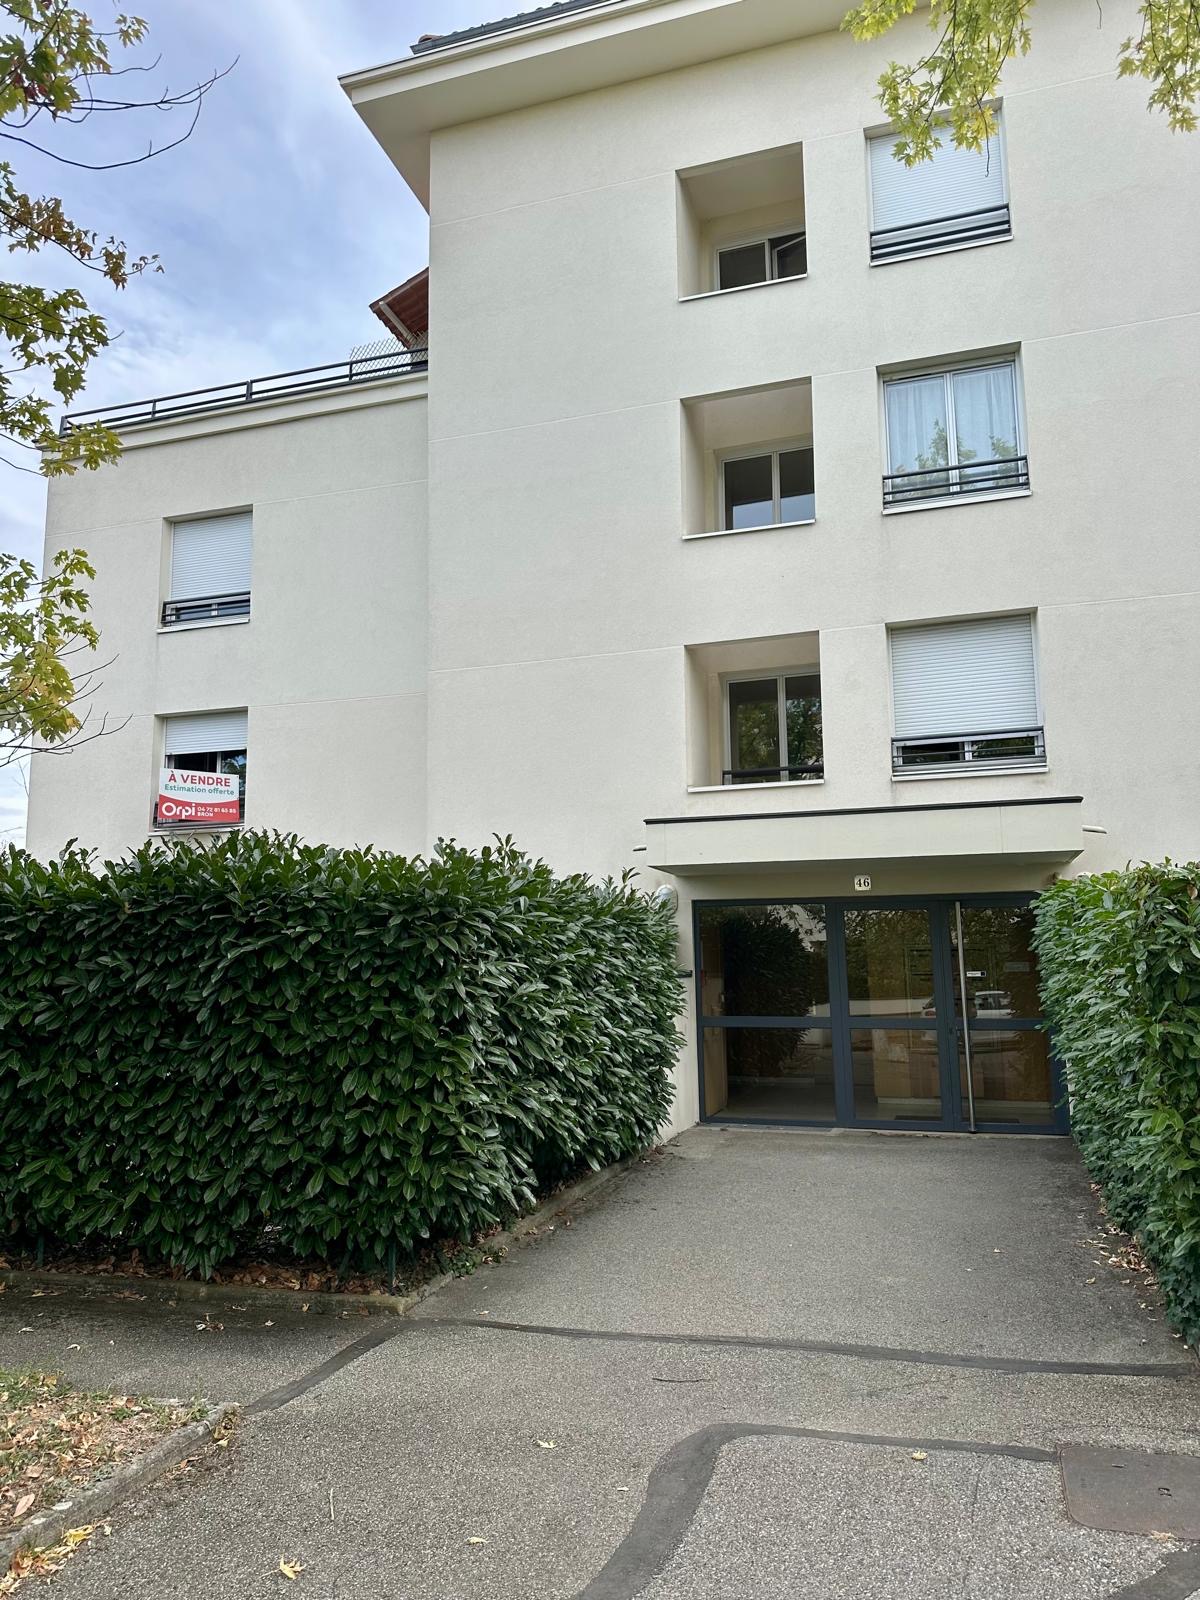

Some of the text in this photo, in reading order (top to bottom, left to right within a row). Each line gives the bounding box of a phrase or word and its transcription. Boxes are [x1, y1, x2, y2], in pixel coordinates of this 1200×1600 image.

[168, 770, 231, 786] À VENDRE
[164, 783, 235, 796] Estimation offerte
[161, 802, 196, 819] Orpi
[855, 878, 869, 887] 46
